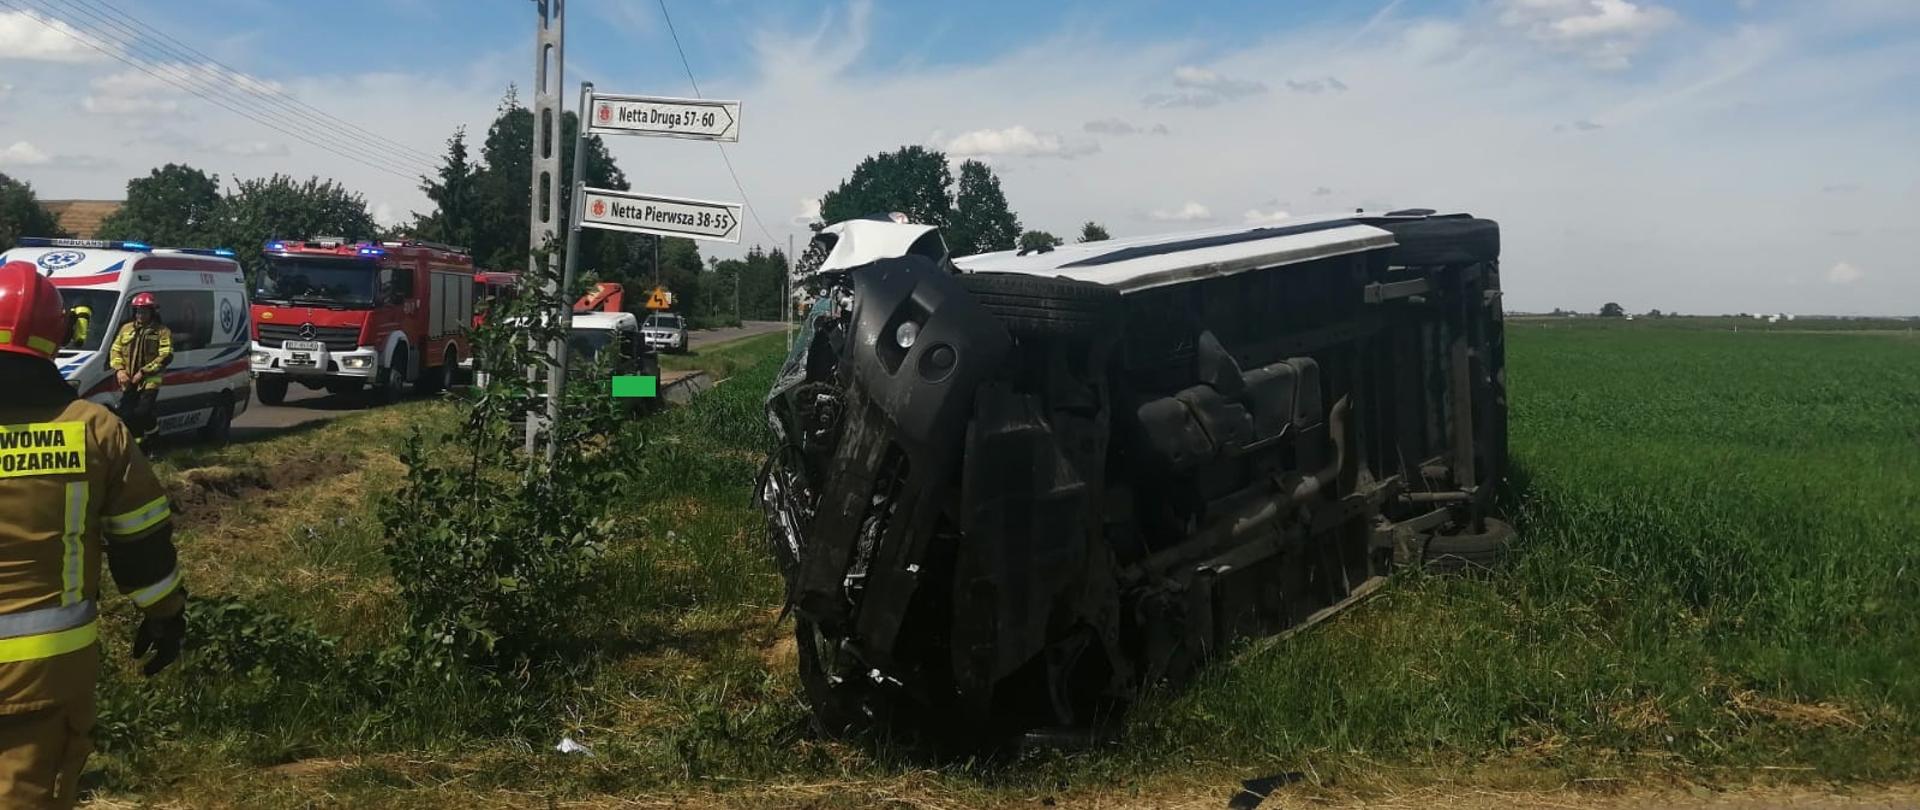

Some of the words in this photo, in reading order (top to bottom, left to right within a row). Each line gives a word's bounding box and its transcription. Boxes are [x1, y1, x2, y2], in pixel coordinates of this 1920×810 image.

[619, 106, 648, 123] Netta
[651, 109, 682, 128] Druga
[611, 202, 643, 221] Netta
[645, 206, 694, 226] Pierwsza
[697, 211, 729, 230] 38-55
[57, 239, 103, 247] AMBULANS
